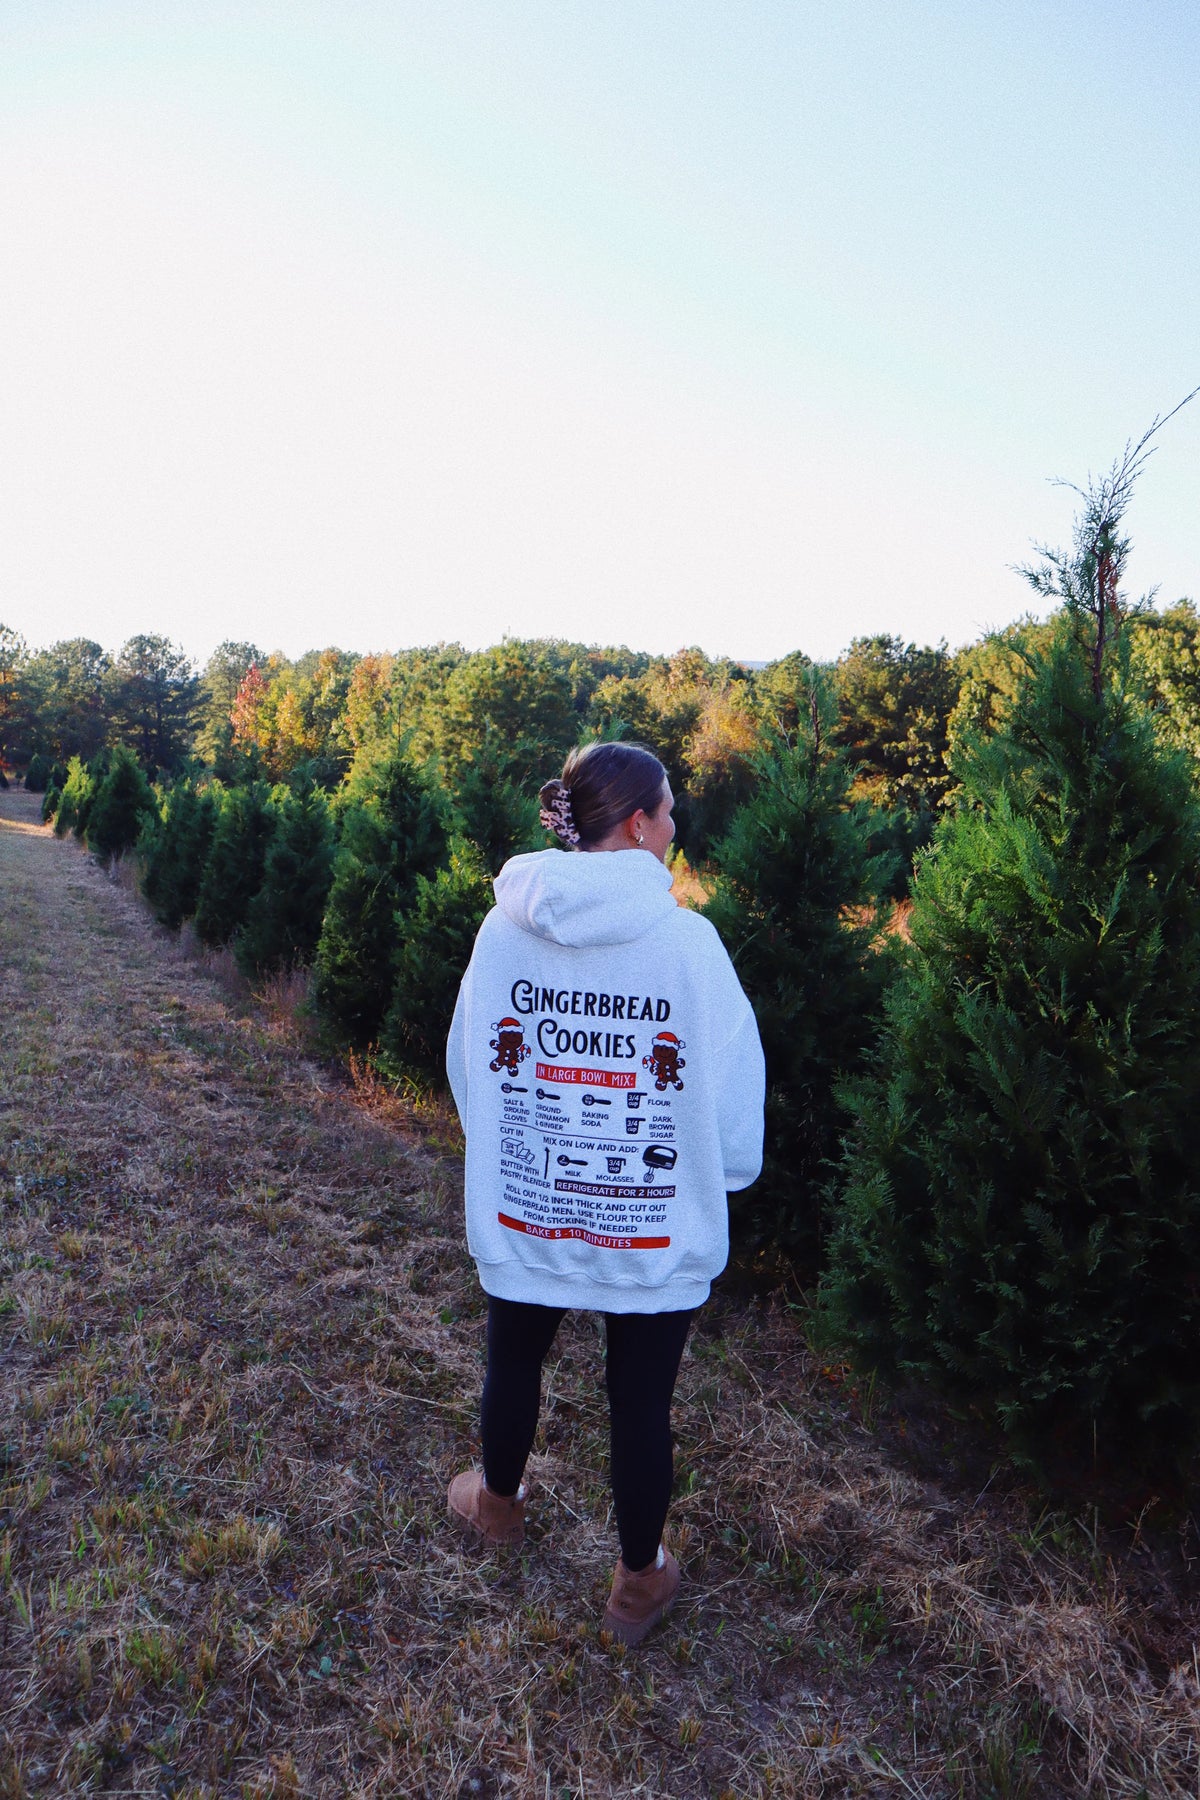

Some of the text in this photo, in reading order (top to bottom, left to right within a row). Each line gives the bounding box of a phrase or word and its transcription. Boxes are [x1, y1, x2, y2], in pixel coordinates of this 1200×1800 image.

[511, 979, 670, 1022] GINGERBREAD
[537, 1018, 636, 1058] COOKIES
[537, 1065, 633, 1086] IN LARGE BOWL MIX:
[503, 1098, 518, 1106] SALT
[647, 1099, 671, 1107] FLOUR
[503, 1106, 530, 1115] GROUND
[535, 1103, 561, 1114] GROUND
[504, 1113, 527, 1122] CLOVES
[535, 1111, 570, 1124] CINNAMON
[581, 1111, 609, 1120] BAKING
[652, 1115, 672, 1123] DARK
[539, 1121, 563, 1131] GINGER
[581, 1119, 602, 1128] SODA
[648, 1123, 675, 1131] BROWN
[500, 1126, 523, 1137] CUT IN
[649, 1131, 674, 1139] SUGAR
[543, 1137, 556, 1146] MIX
[559, 1139, 572, 1148] ON
[575, 1142, 595, 1151] LOW
[596, 1144, 616, 1152] AND
[500, 1159, 540, 1176] BUTTER WITH
[608, 1159, 620, 1167] 3/4
[500, 1169, 551, 1189] PASTRY BLENDER
[565, 1170, 581, 1178] MILK
[595, 1174, 635, 1183] MOLASSES
[556, 1181, 674, 1197] REFRIGERATE FOR 2 HOURS
[506, 1183, 667, 1212] ROLL OUT 1/2 INCH THICK AND CUT OUT
[503, 1193, 550, 1213] GINGERBREAD
[578, 1209, 594, 1219] USE
[596, 1213, 627, 1223] FLOUR
[629, 1215, 642, 1223] TO
[644, 1215, 667, 1223] KEEP
[523, 1210, 638, 1233] FROM STICKING IF NEEDED
[525, 1224, 551, 1238] BAKE
[554, 1229, 562, 1238] 8
[583, 1231, 632, 1248] MINUTES
